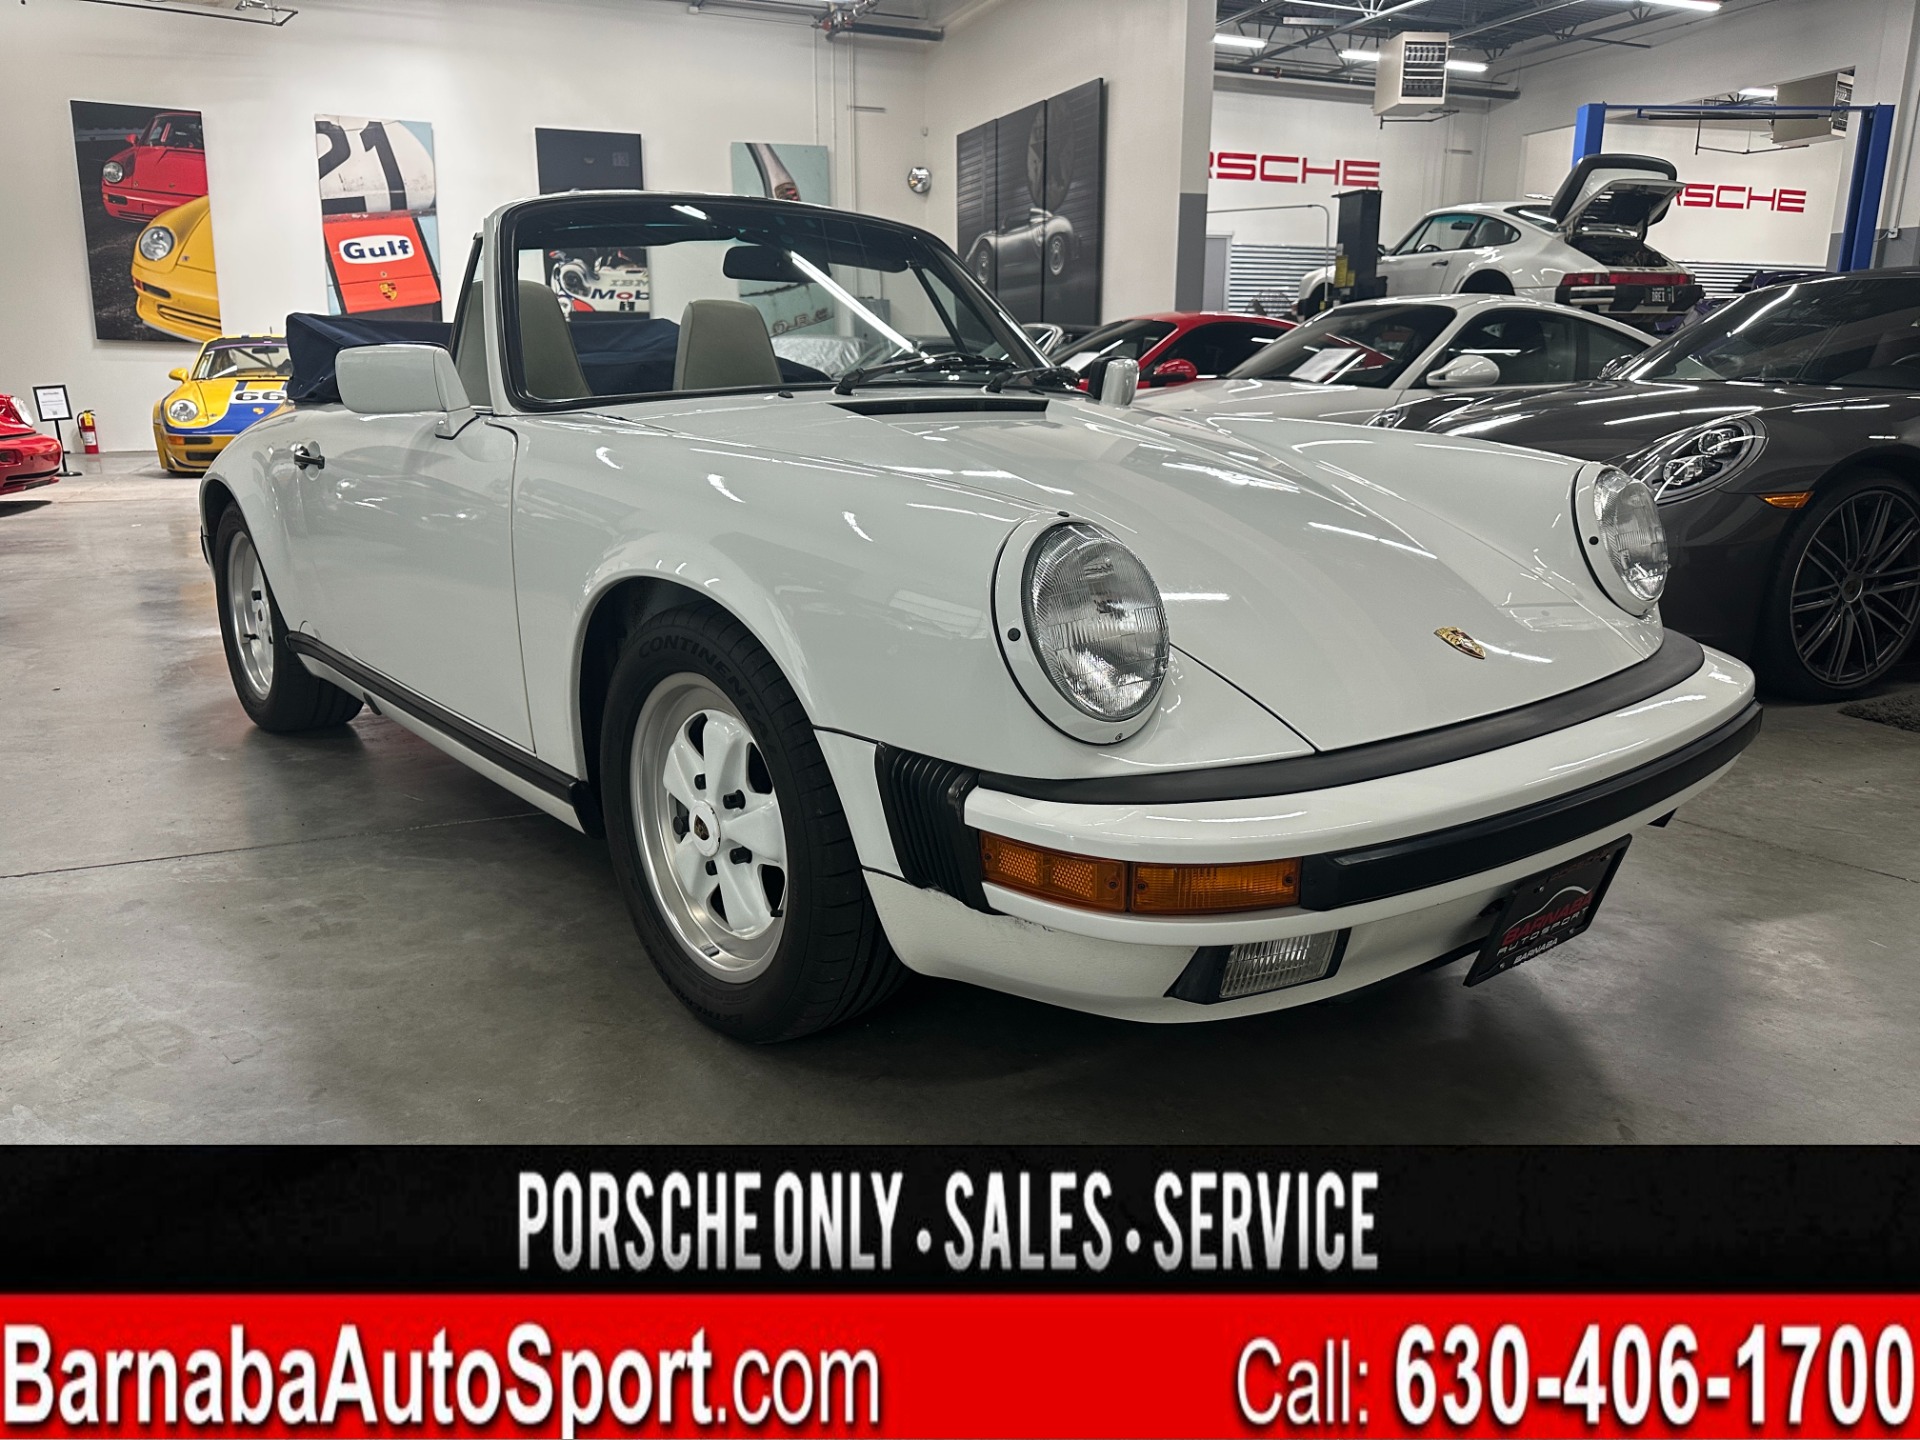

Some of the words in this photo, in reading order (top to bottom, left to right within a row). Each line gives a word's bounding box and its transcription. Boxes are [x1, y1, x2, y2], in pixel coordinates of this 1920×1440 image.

[315, 121, 408, 215] 21
[1208, 152, 1380, 187] SCHE
[1676, 183, 1807, 213] SCHE
[342, 239, 409, 259] Gulf
[590, 288, 649, 300] Mob
[234, 391, 286, 401] 66
[638, 634, 777, 755] CONTINENTAL
[1496, 906, 1590, 957] AUTOSPORT
[1501, 890, 1594, 947] BARNABA
[1513, 937, 1559, 965] BARNABA
